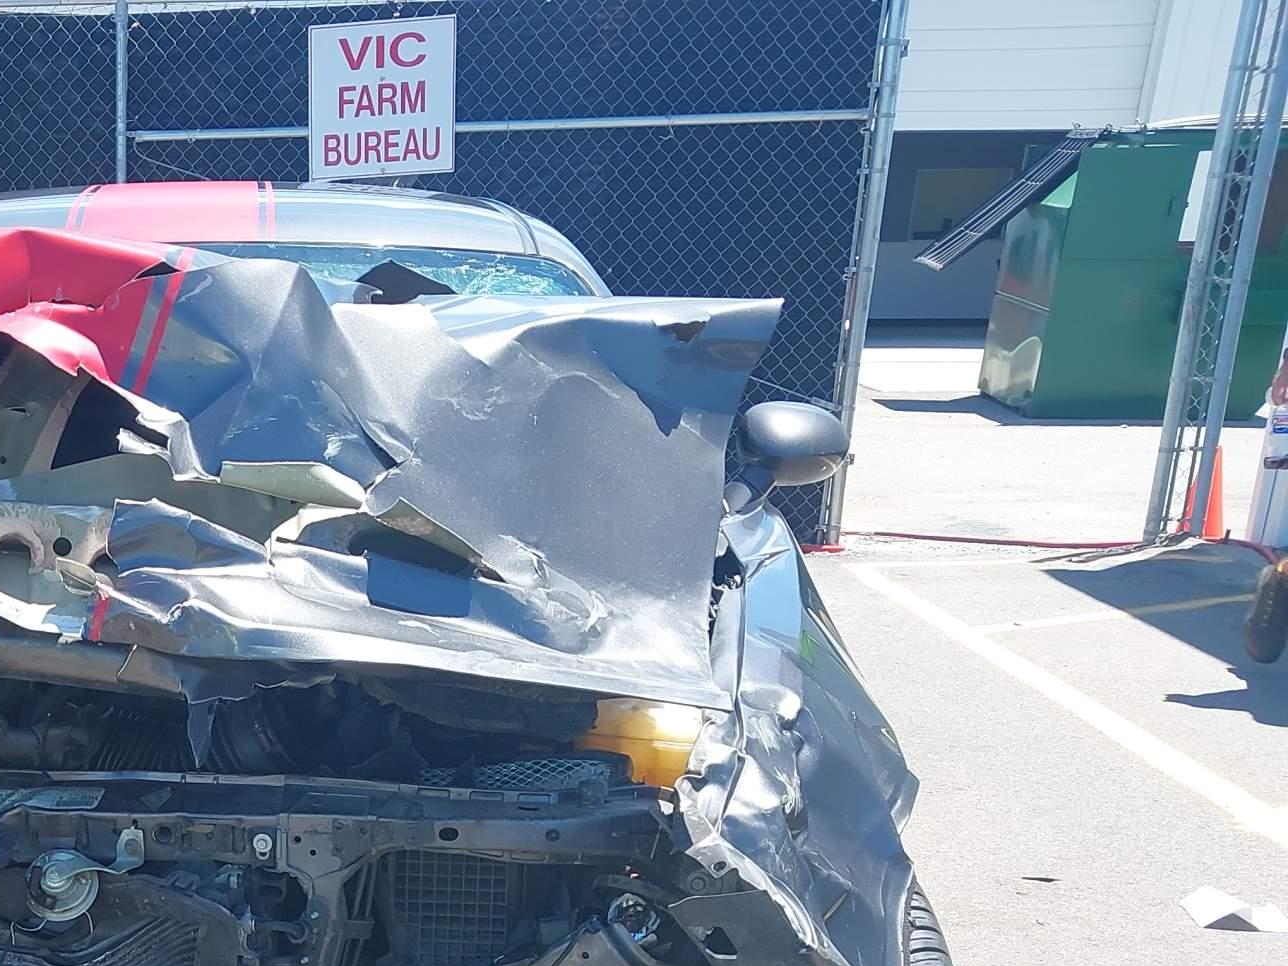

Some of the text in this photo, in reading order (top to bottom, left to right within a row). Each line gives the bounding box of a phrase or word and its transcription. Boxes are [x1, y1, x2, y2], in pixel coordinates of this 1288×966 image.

[338, 32, 426, 71] VIC
[338, 80, 426, 119] FARM
[323, 126, 441, 167] BUREAU
